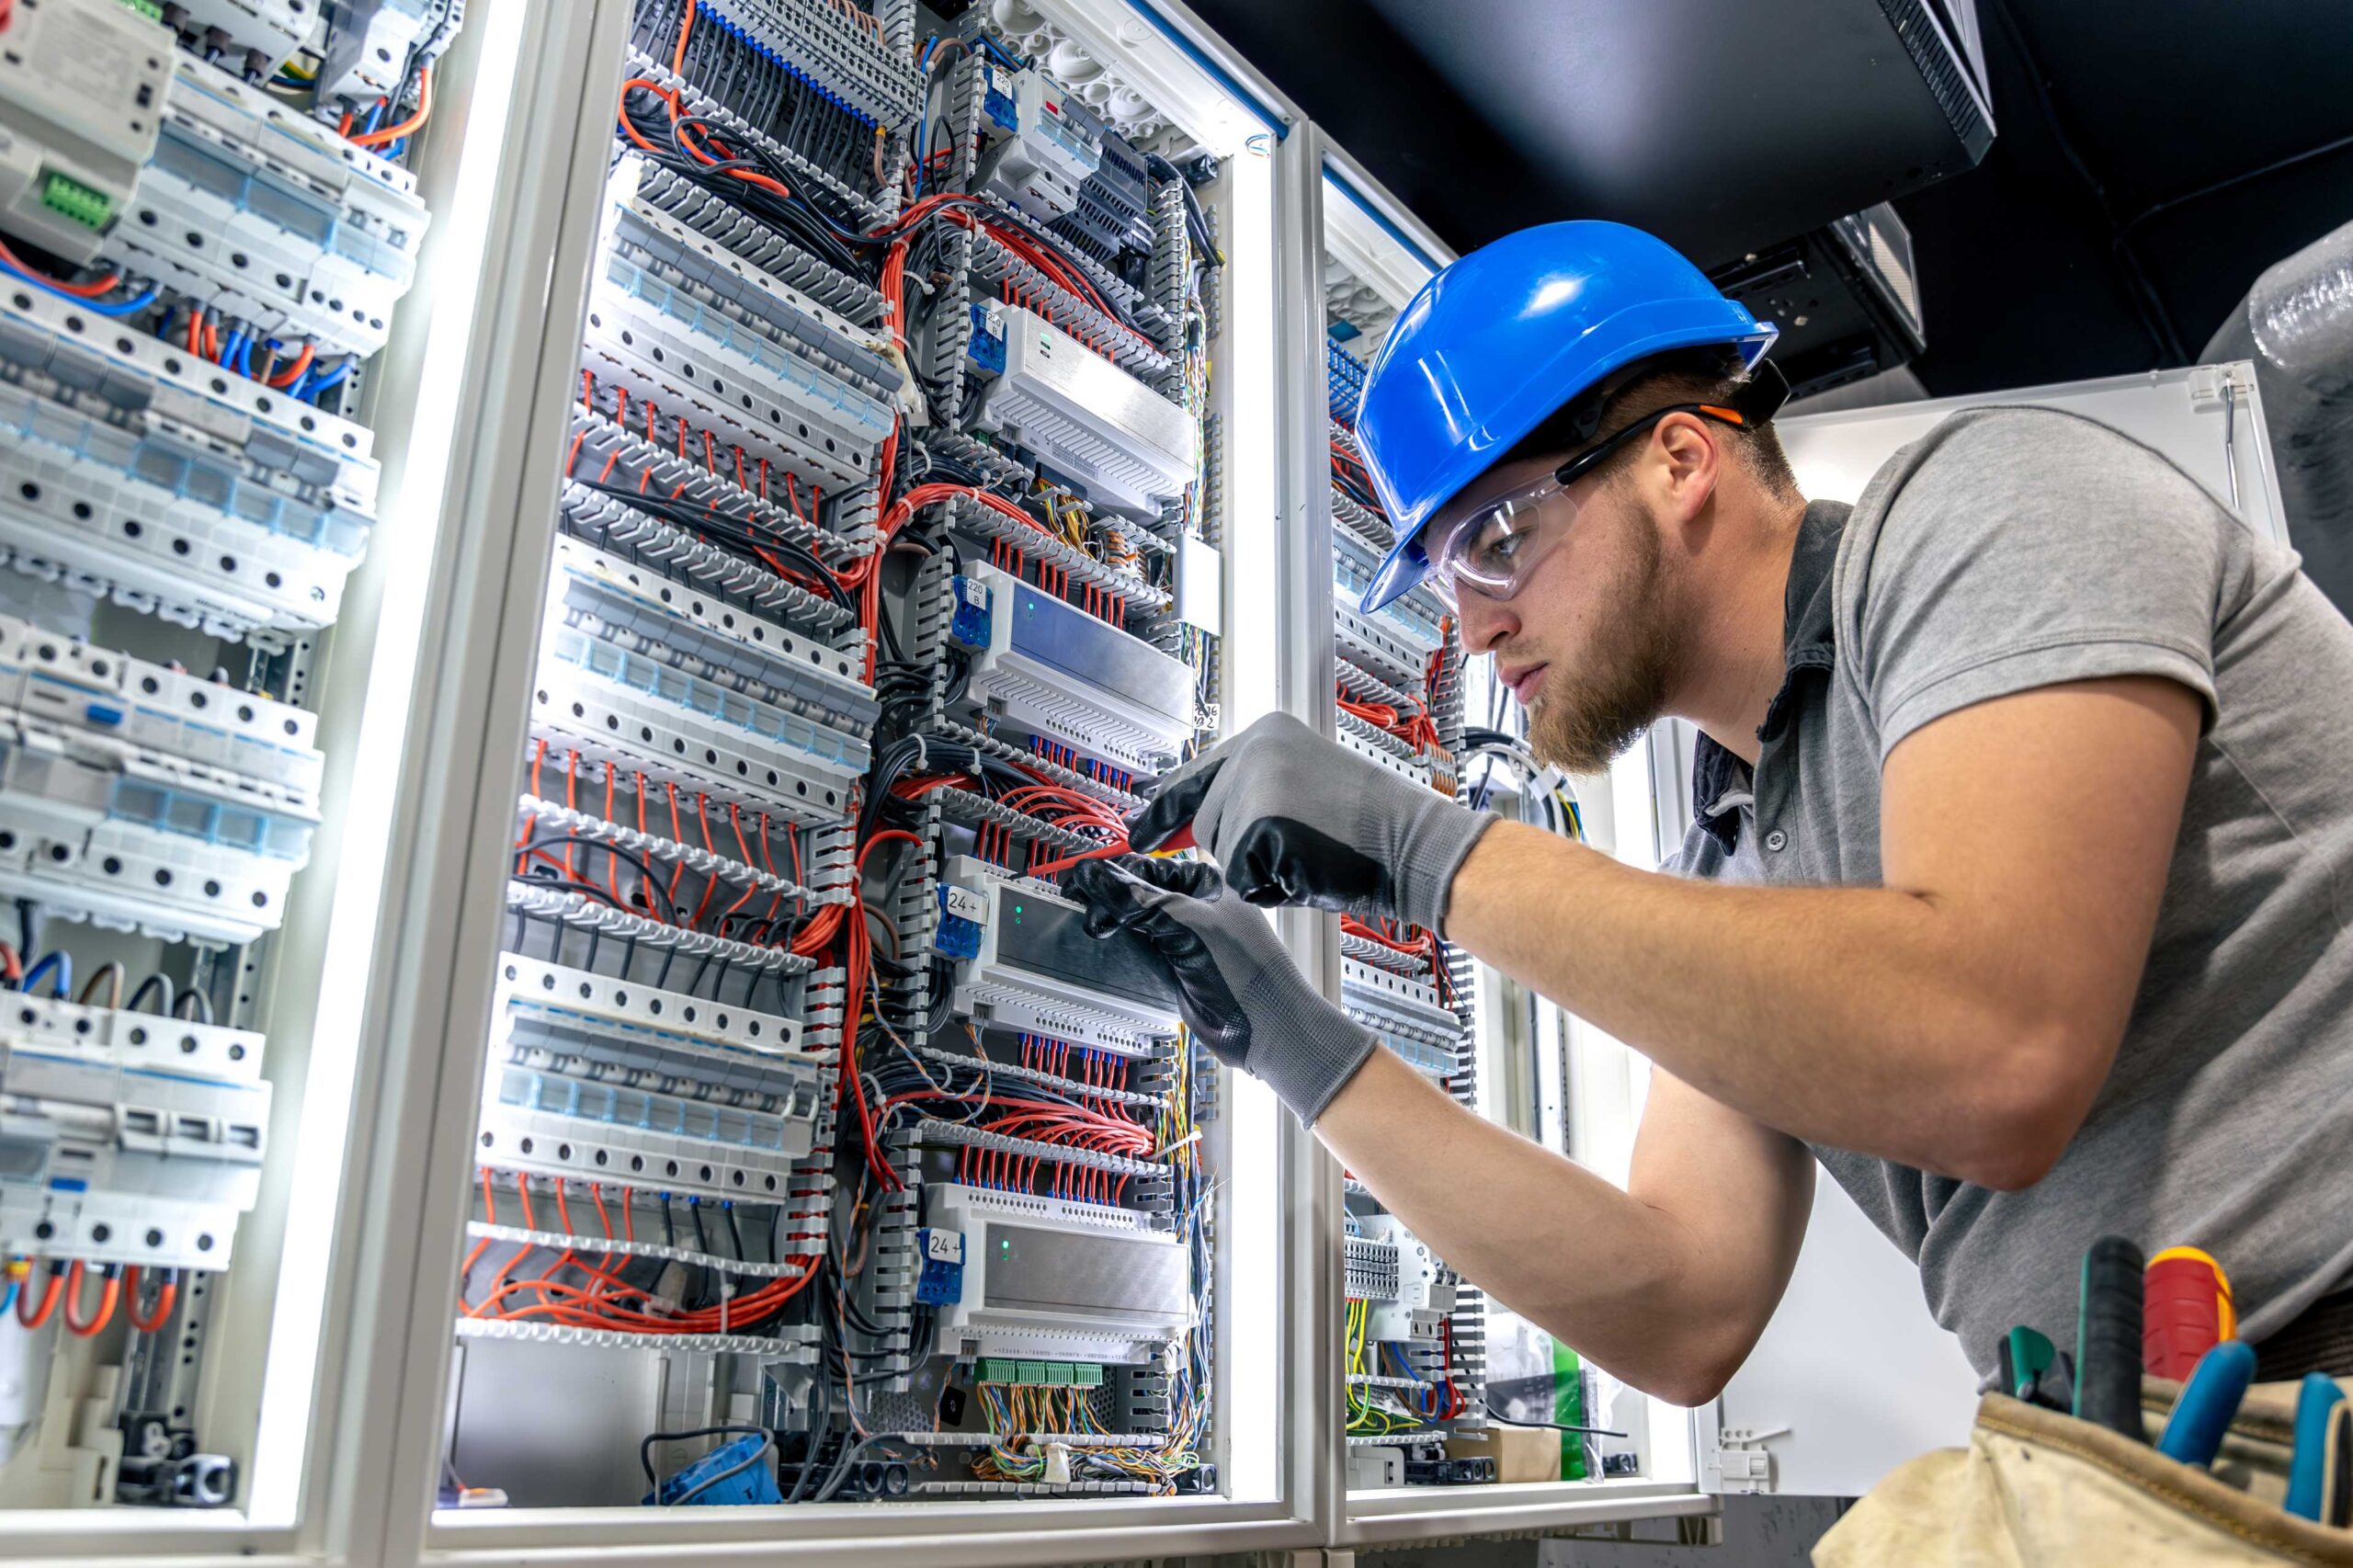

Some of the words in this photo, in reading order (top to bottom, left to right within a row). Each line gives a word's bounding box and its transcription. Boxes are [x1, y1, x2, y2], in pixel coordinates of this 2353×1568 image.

[968, 581, 983, 595] 220
[949, 892, 966, 911] 24
[931, 1235, 949, 1255] 24
